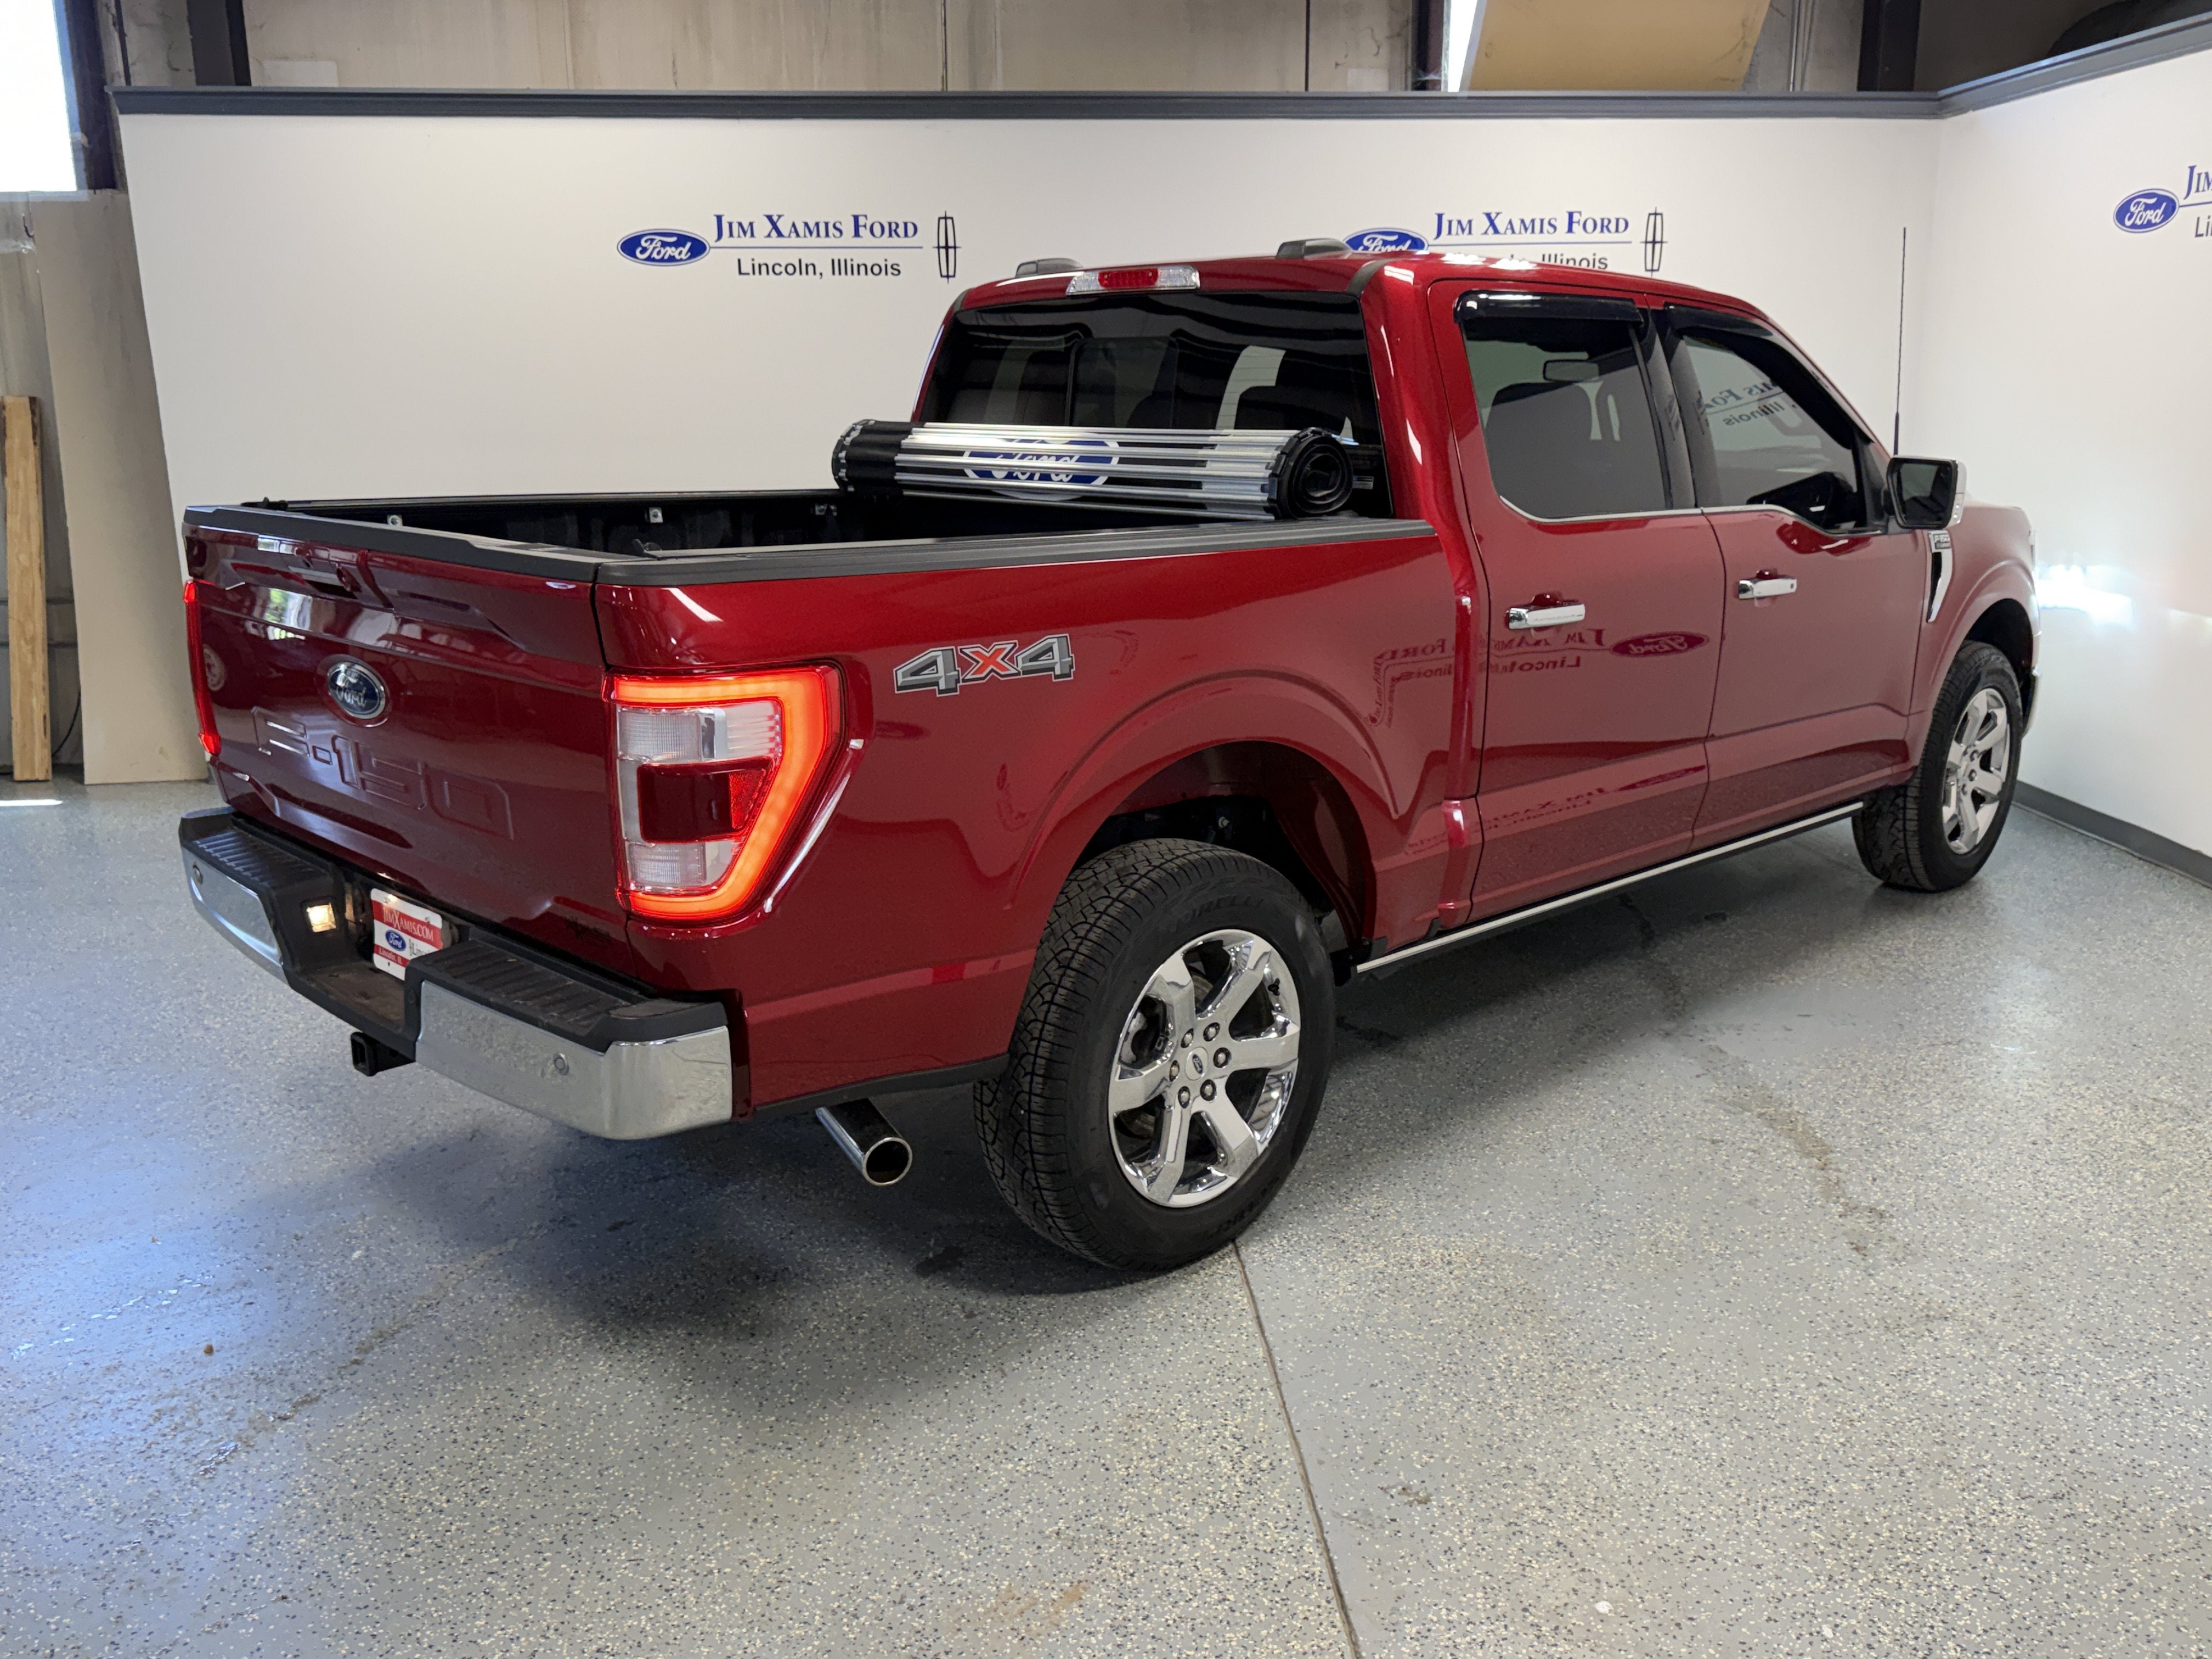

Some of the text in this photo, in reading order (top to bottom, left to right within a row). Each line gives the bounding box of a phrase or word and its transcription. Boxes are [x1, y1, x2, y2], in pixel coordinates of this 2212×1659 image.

[2124, 197, 2168, 226] Ford
[635, 235, 692, 260] Ford
[736, 258, 901, 279] Lincoln, Illinois
